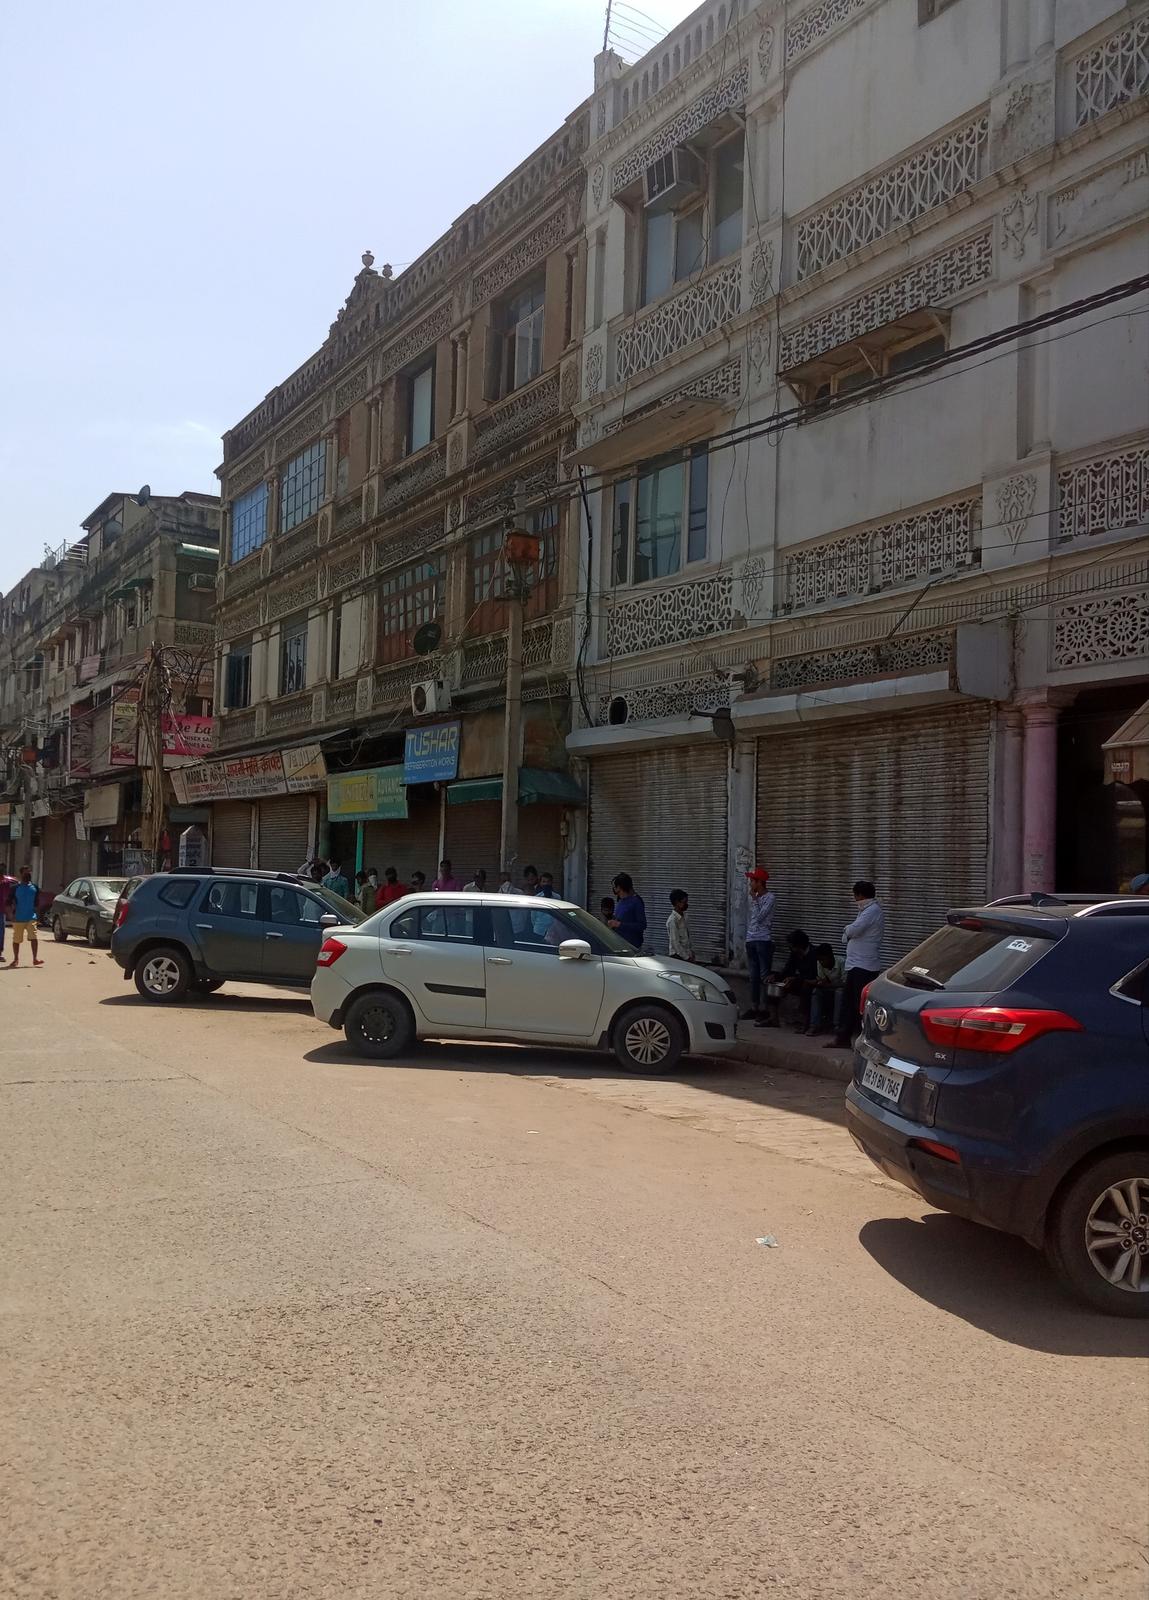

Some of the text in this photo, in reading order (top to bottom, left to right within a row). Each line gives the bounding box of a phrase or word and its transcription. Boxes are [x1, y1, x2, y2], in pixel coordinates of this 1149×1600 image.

[407, 727, 457, 757] TUSHAR
[438, 756, 456, 767] WORKS
[934, 1052, 947, 1060] SX
[871, 1072, 877, 1085] 51
[877, 1075, 886, 1091] BN
[885, 1077, 900, 1097] 7645
